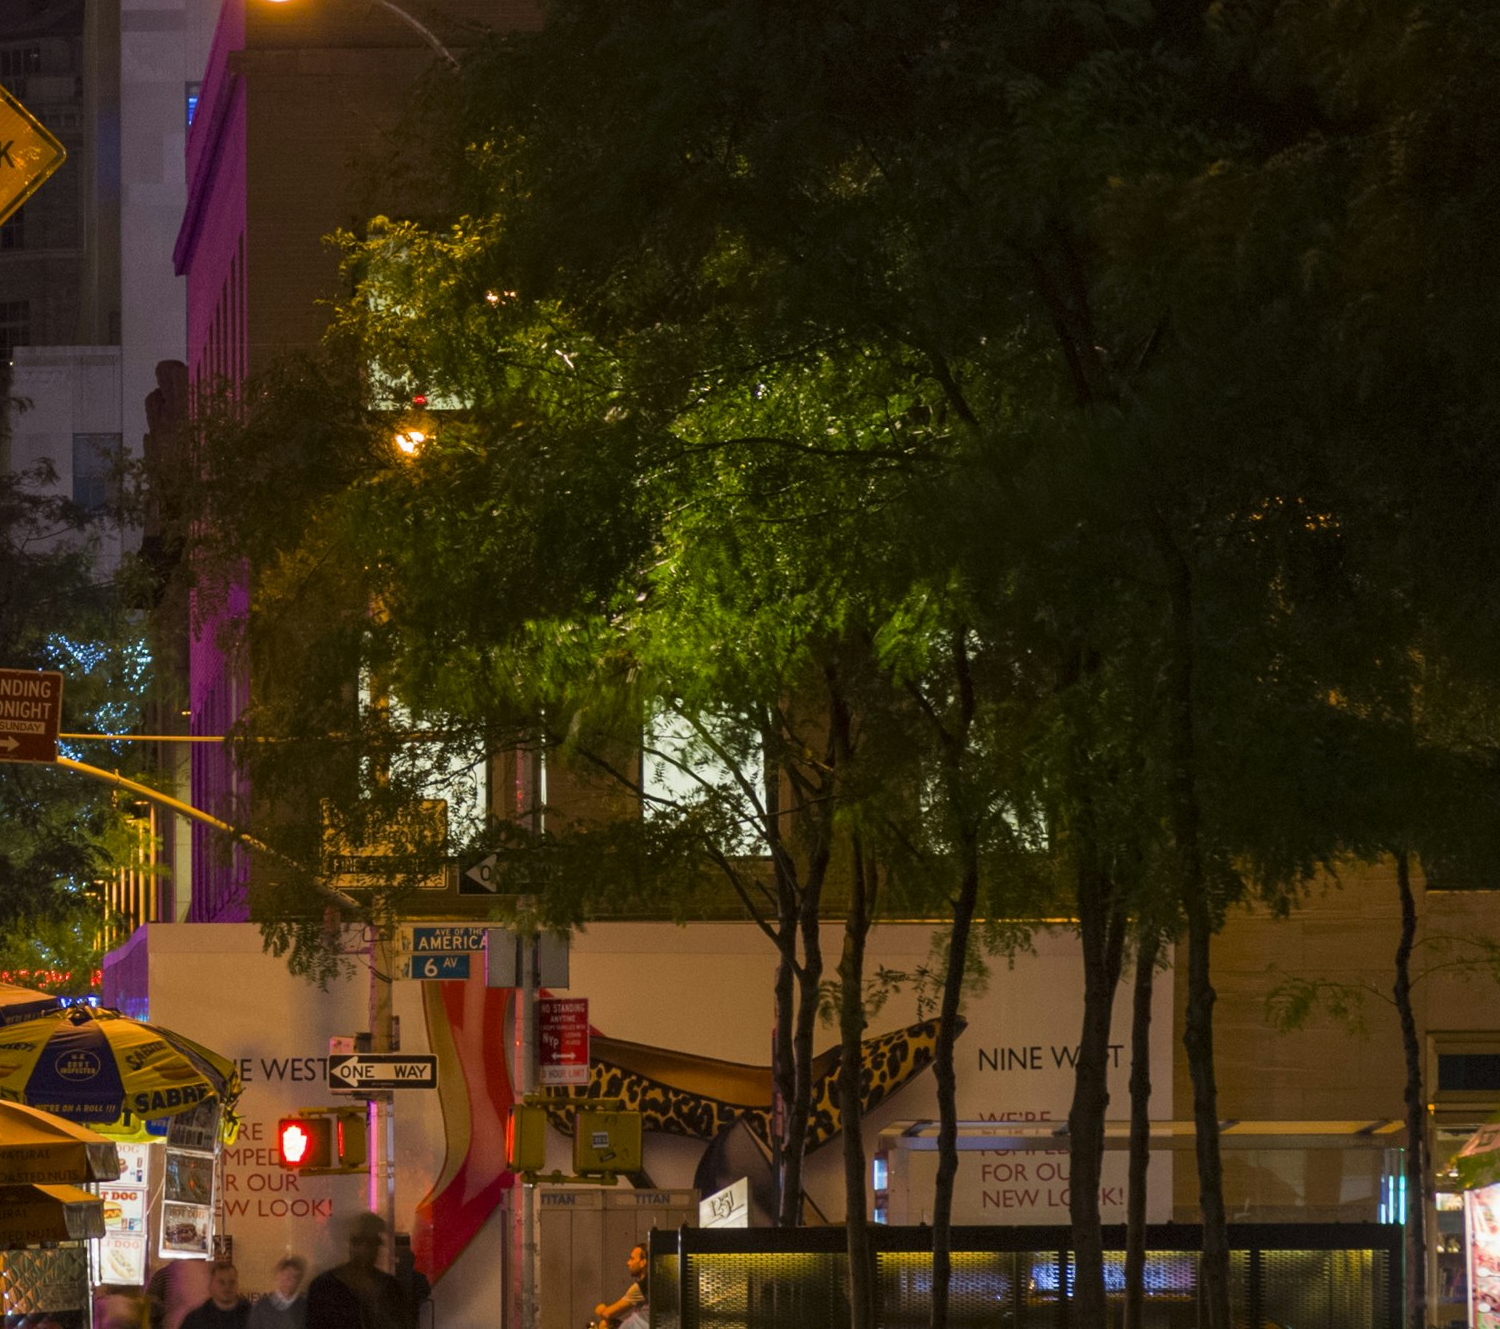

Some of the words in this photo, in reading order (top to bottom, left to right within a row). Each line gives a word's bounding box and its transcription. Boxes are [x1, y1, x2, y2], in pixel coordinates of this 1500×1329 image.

[435, 928, 451, 936] AVE
[454, 928, 465, 936] OF
[469, 928, 484, 936] THE
[418, 936, 486, 950] AMERICA
[424, 958, 438, 977] 6
[443, 958, 458, 968] AV
[979, 1046, 1043, 1070] NINE
[1051, 1045, 1124, 1069] WT
[261, 1058, 329, 1082] WEST
[340, 1065, 375, 1078] ONE
[394, 1064, 428, 1078] WAY
[982, 1164, 1028, 1182] FOR
[1036, 1163, 1070, 1181] OU
[247, 1173, 300, 1192] OUR
[111, 1192, 138, 1201] DOG
[541, 1195, 576, 1205] TITAN
[635, 1194, 670, 1204] TITAN
[983, 1189, 1039, 1209] NEW
[258, 1199, 333, 1218] LOOK!
